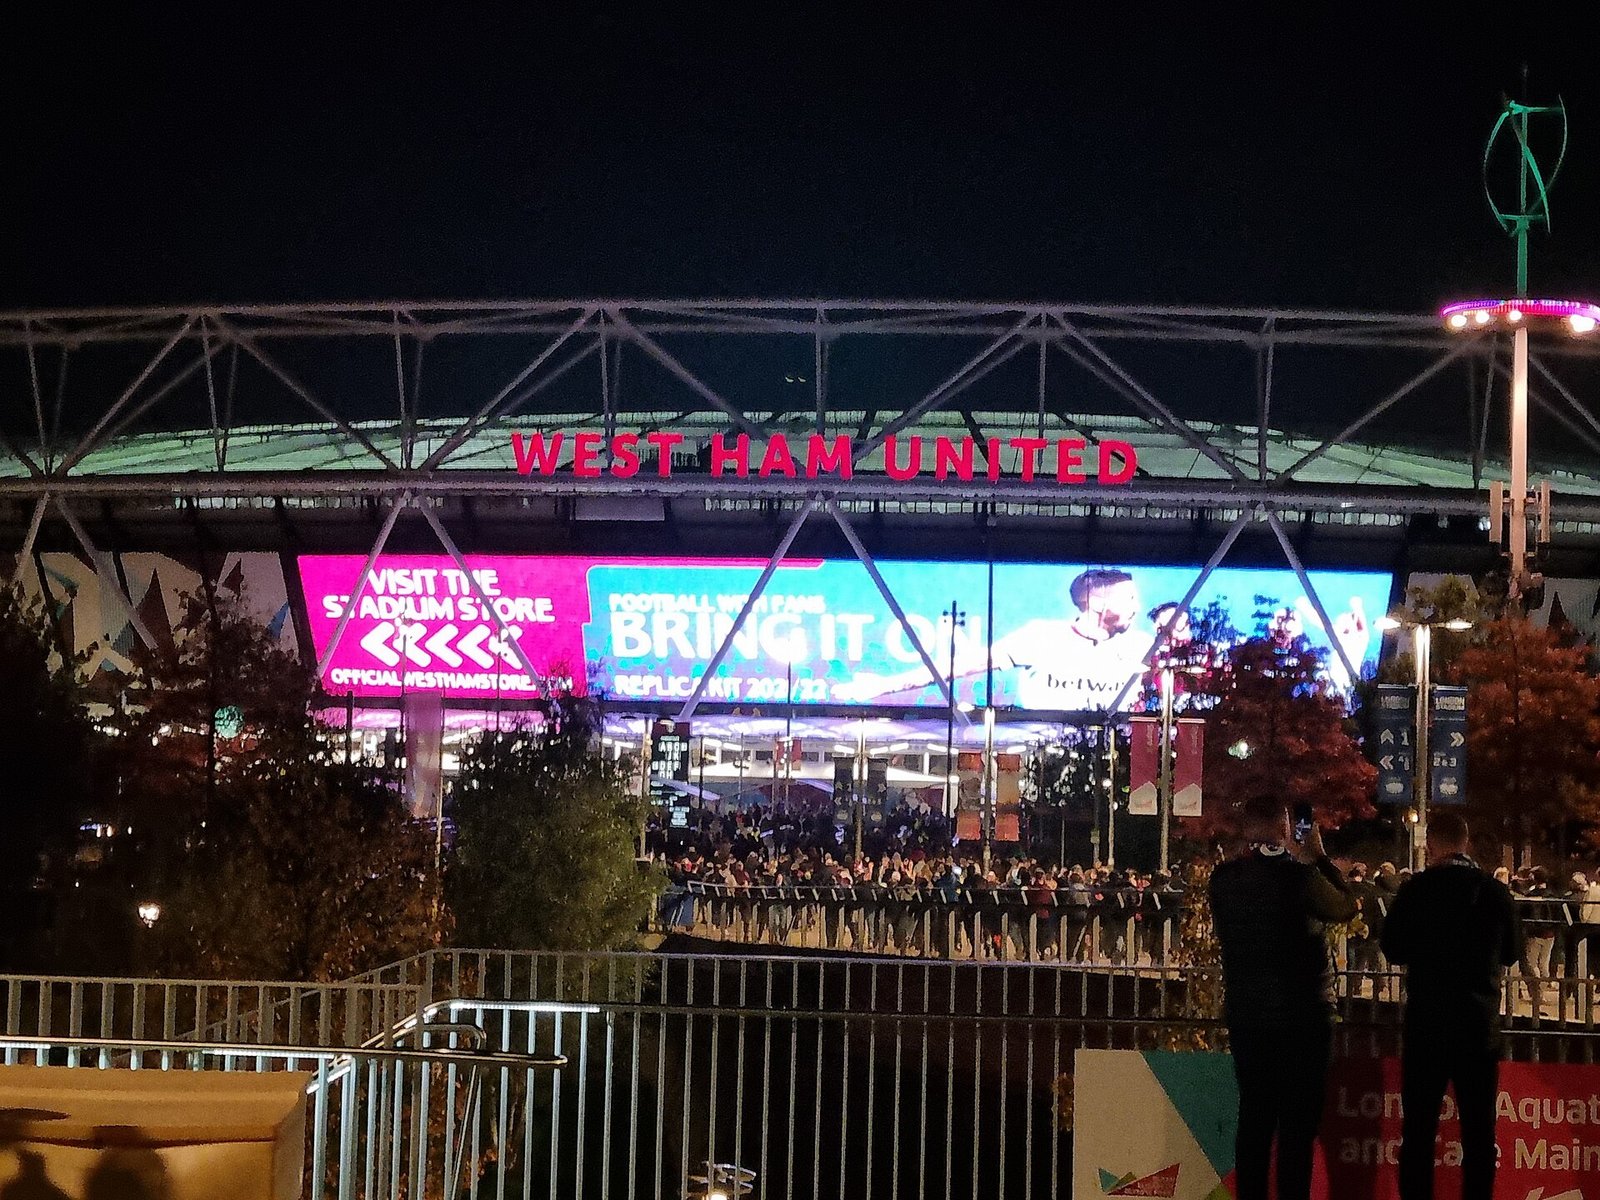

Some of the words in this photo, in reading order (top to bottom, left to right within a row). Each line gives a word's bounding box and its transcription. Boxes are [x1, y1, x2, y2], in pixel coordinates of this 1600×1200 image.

[511, 432, 684, 478] WEST
[711, 433, 853, 480] HAM
[885, 435, 1138, 485] UNITED
[368, 568, 438, 595] VISIT
[442, 568, 501, 596] THE
[322, 595, 455, 621] STADIUM
[457, 597, 555, 623] STORE
[610, 612, 807, 664] BRING
[820, 614, 874, 662] IT
[886, 614, 982, 664] ON
[707, 677, 742, 699] KIT
[1048, 674, 1125, 692] betwa
[1337, 1087, 1460, 1121] Lono
[1515, 1138, 1600, 1171] Main
